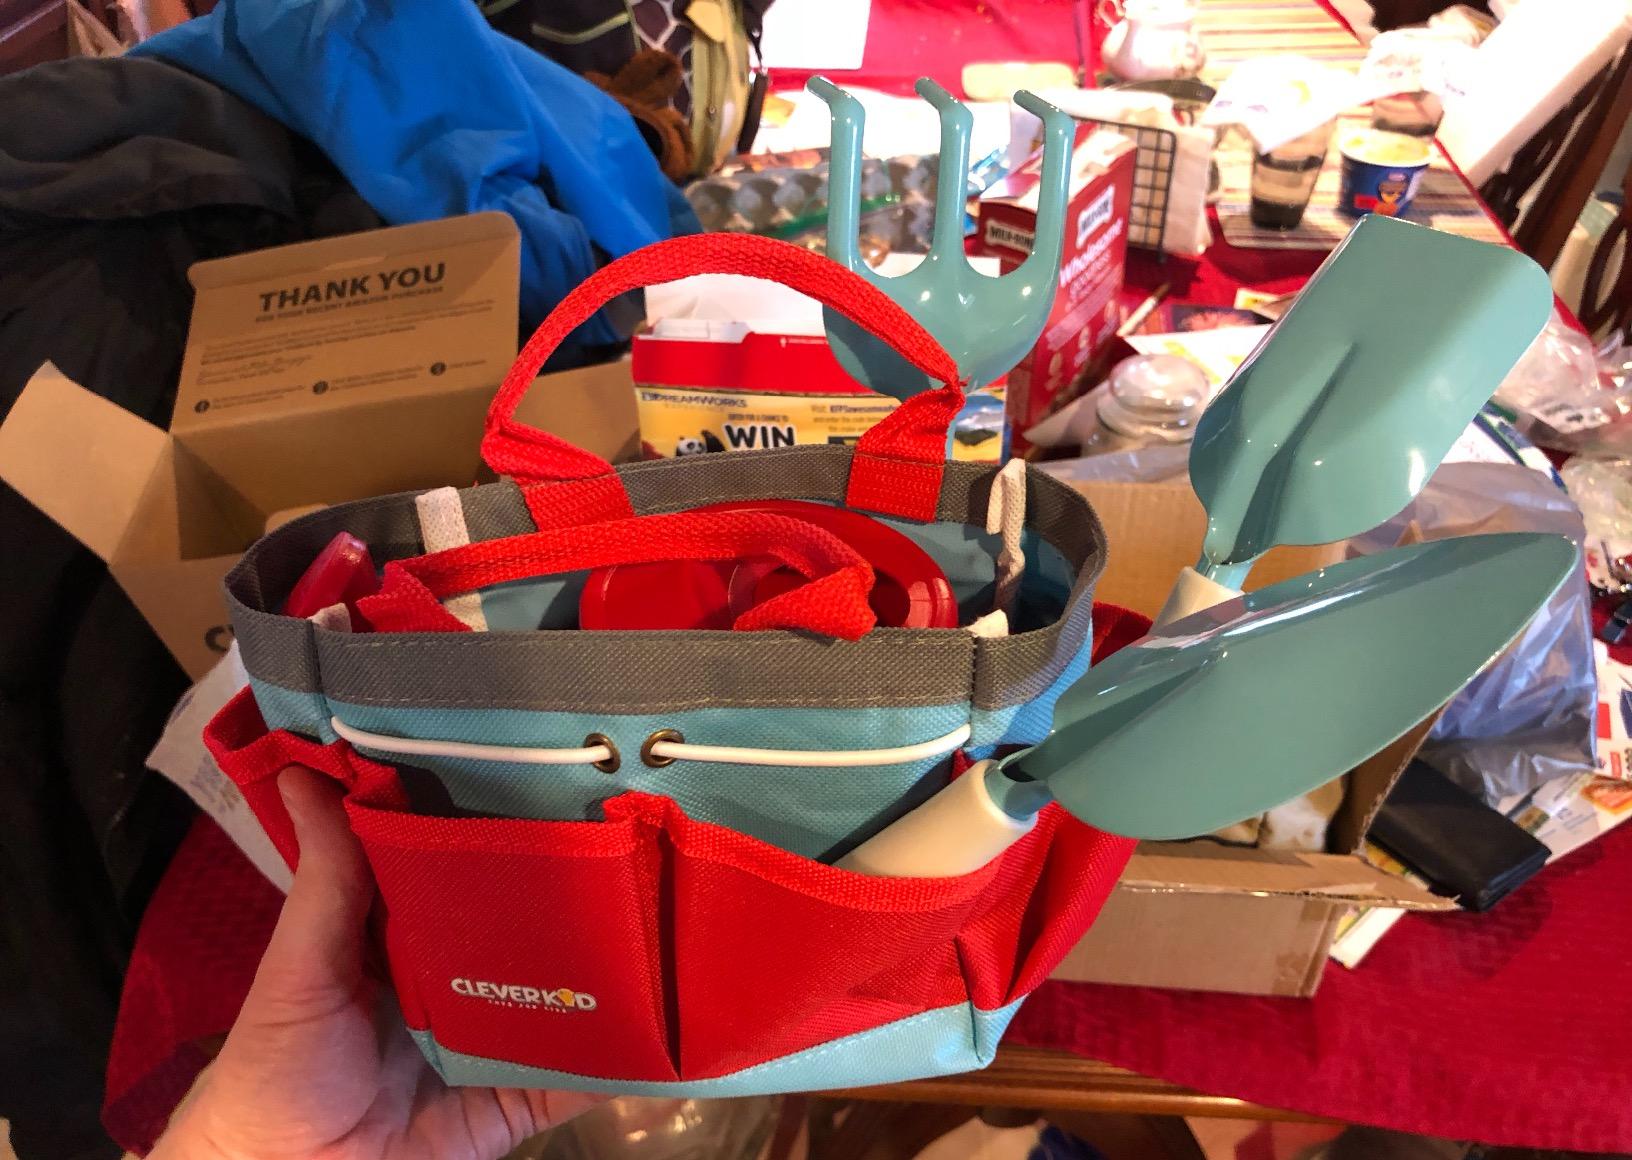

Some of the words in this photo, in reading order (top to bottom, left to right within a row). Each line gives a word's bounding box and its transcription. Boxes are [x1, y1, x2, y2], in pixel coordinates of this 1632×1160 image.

[259, 275, 370, 312] THANK
[378, 262, 445, 291] YOU
[725, 424, 794, 449] WIN
